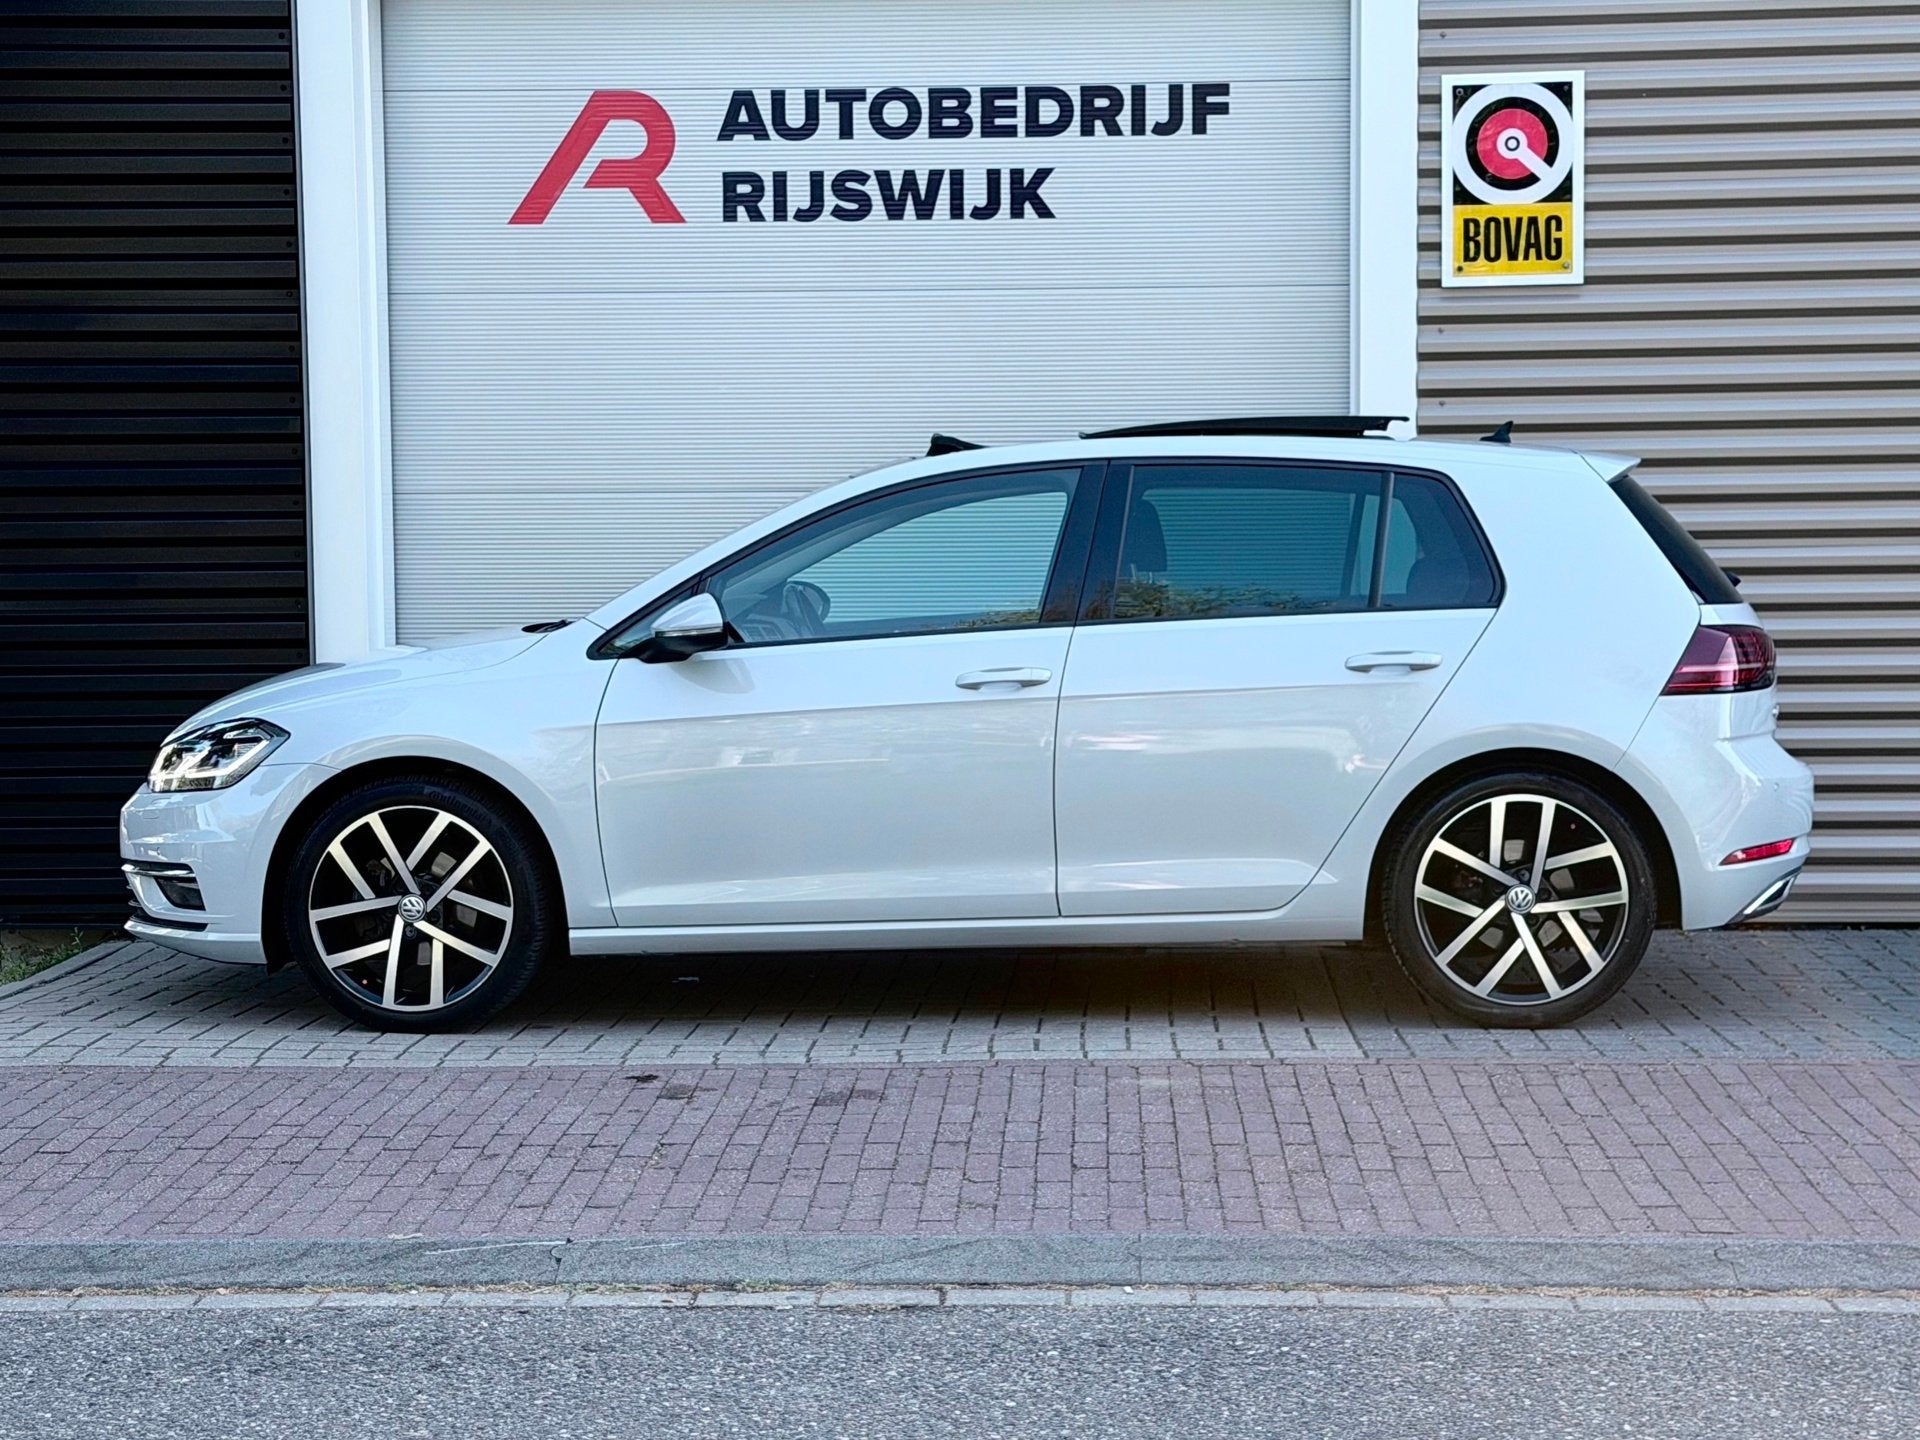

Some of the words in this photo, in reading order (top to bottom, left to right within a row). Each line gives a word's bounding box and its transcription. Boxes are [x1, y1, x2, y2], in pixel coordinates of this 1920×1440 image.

[718, 83, 1229, 141] AUTOBEDRIJF
[723, 168, 1054, 222] RIJSWIJK
[1463, 215, 1562, 262] BOVAG
